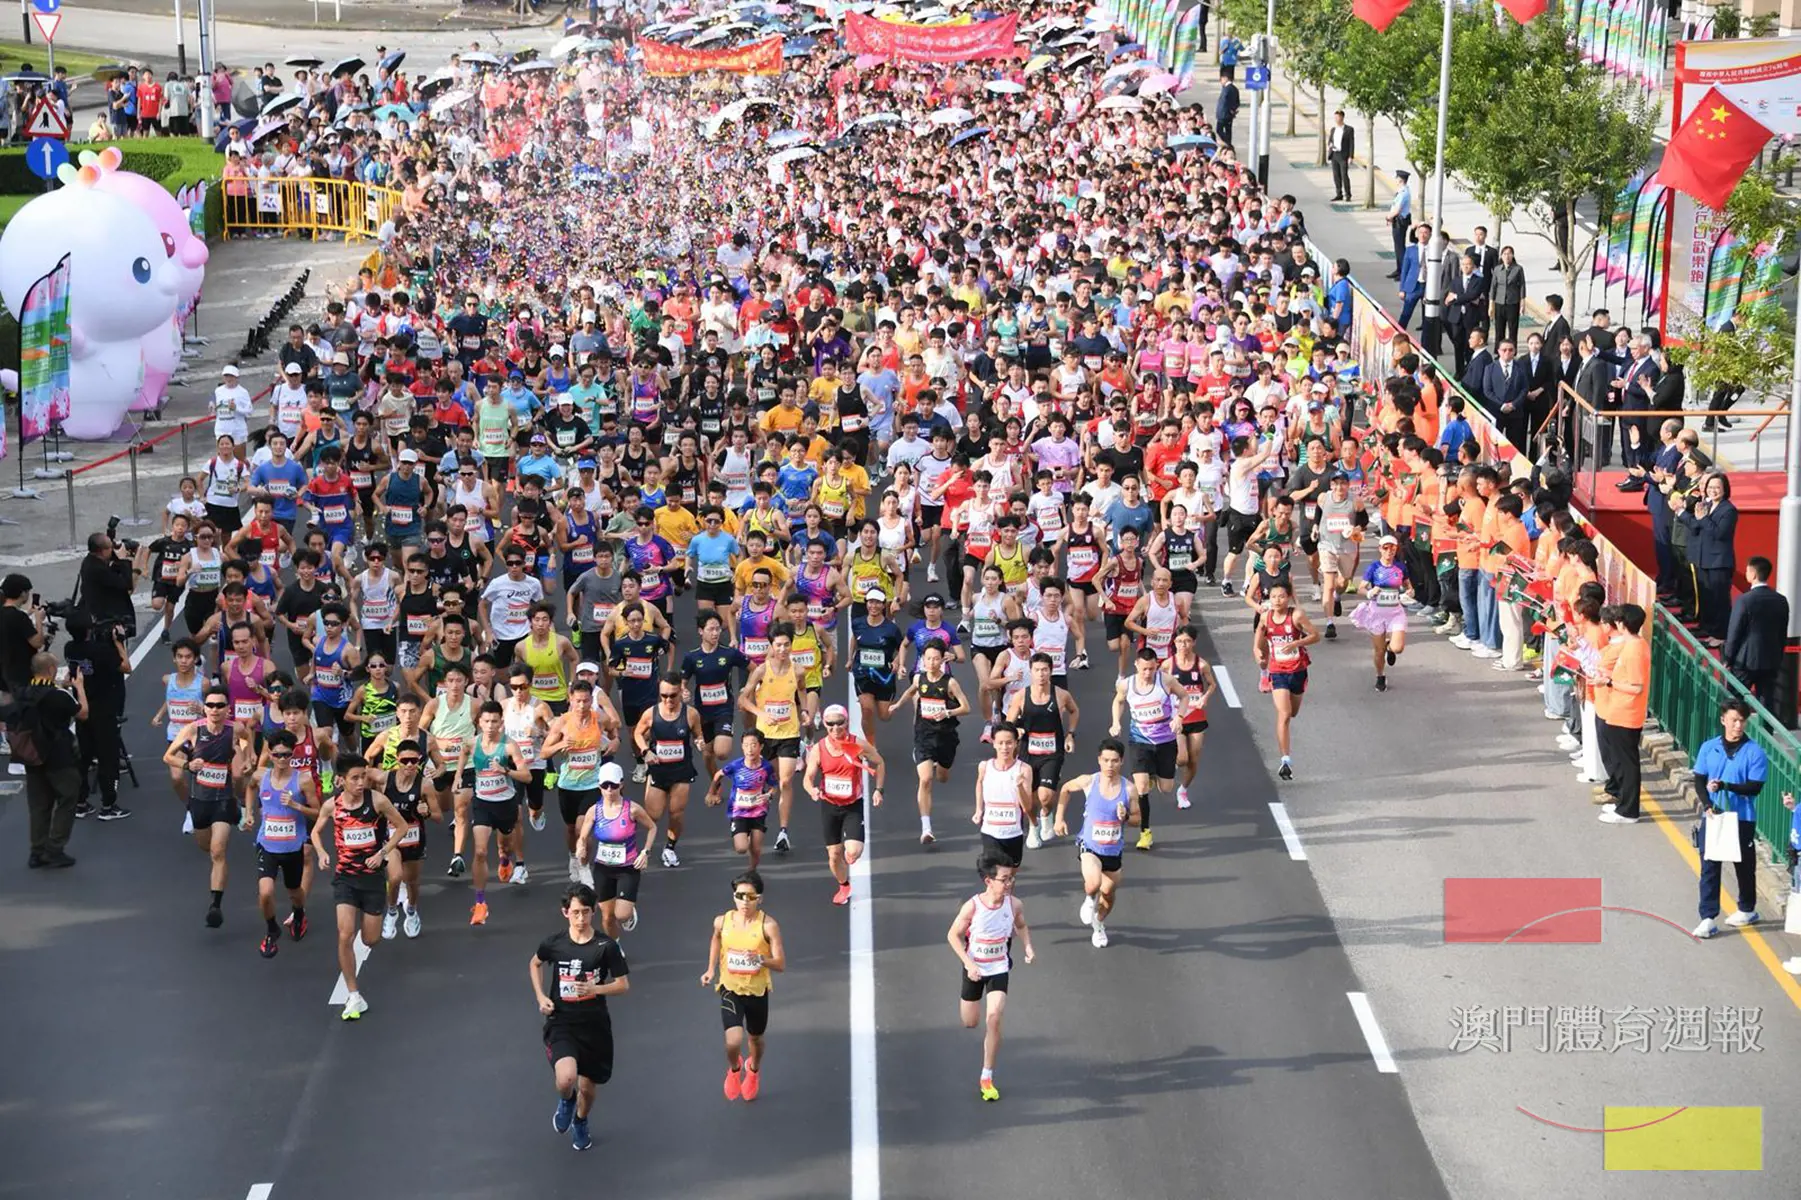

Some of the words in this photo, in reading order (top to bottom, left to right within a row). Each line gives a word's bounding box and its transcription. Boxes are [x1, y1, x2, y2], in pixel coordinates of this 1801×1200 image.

[657, 747, 682, 756] A0244
[198, 769, 226, 780] A0405
[266, 825, 294, 835] A0412
[345, 831, 373, 841] A0234
